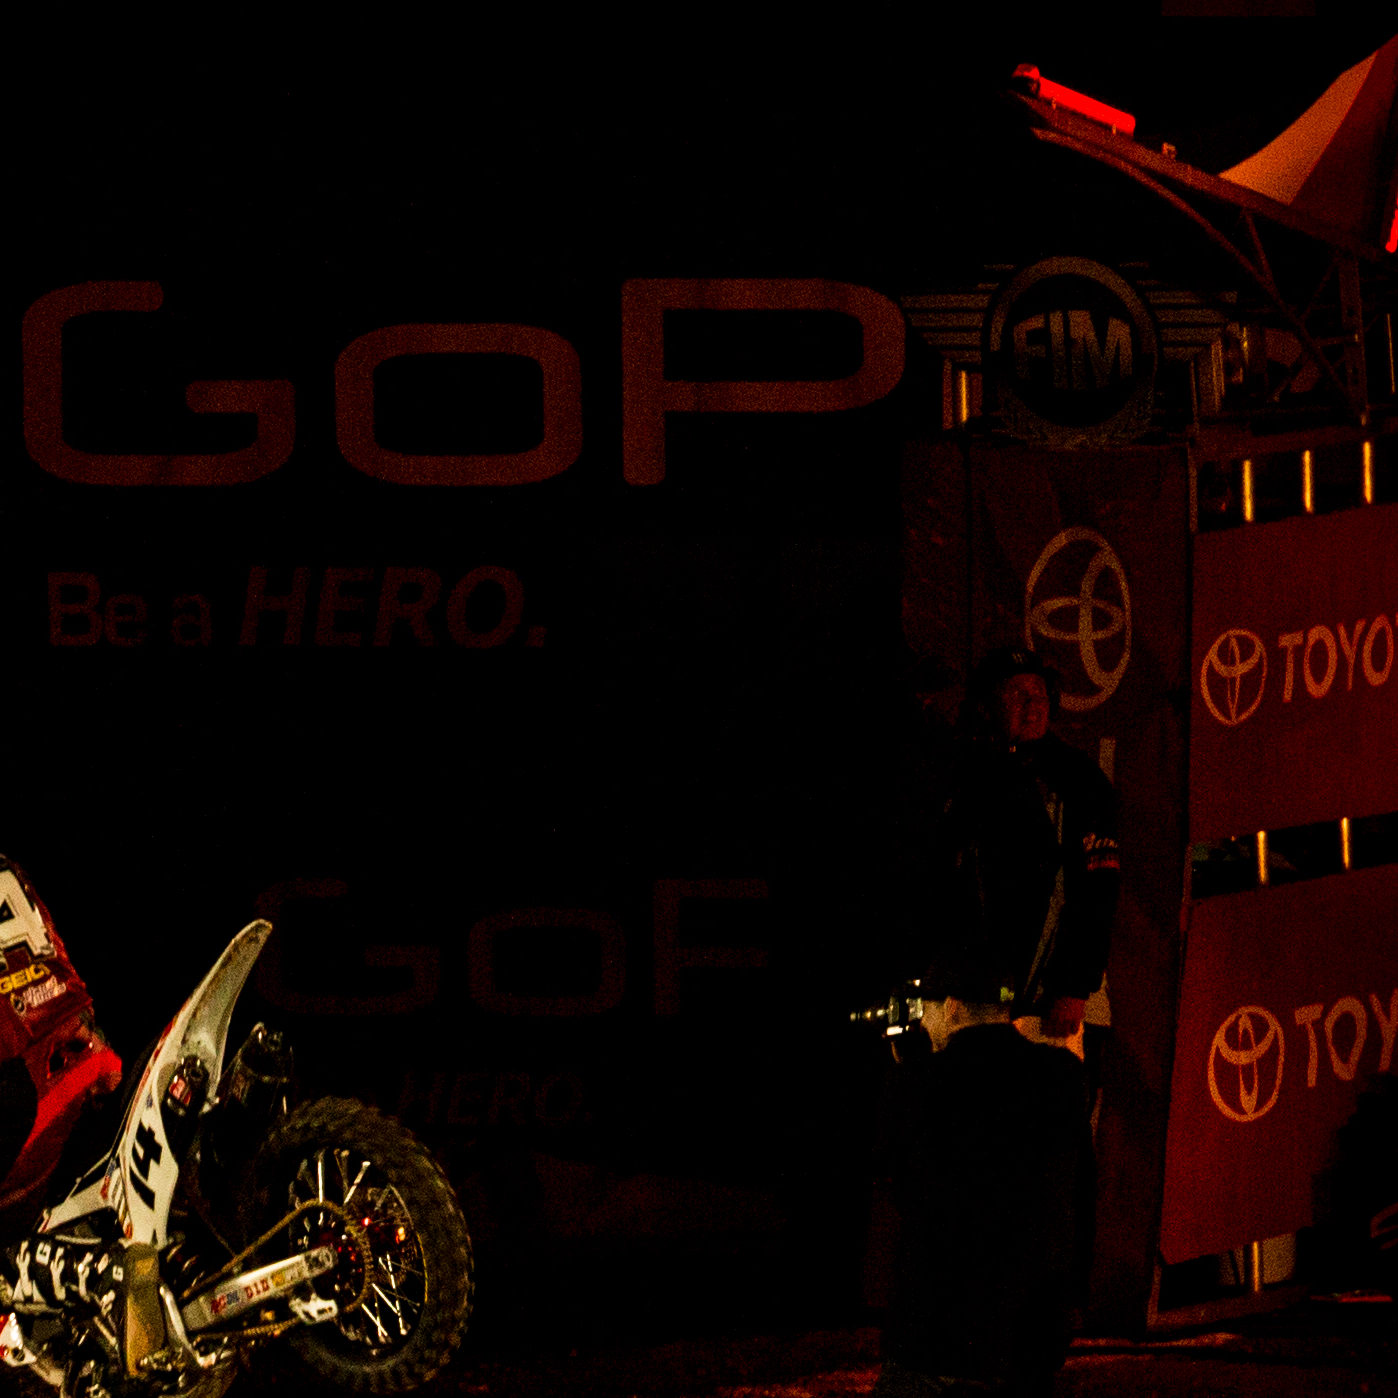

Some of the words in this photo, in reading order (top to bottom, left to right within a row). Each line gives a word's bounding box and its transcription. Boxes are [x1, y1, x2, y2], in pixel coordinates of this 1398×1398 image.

[1012, 308, 1134, 392] FIM
[45, 570, 146, 648] Be
[170, 592, 212, 648] a
[238, 564, 550, 650] HERO.
[1279, 612, 1398, 702] TOYO
